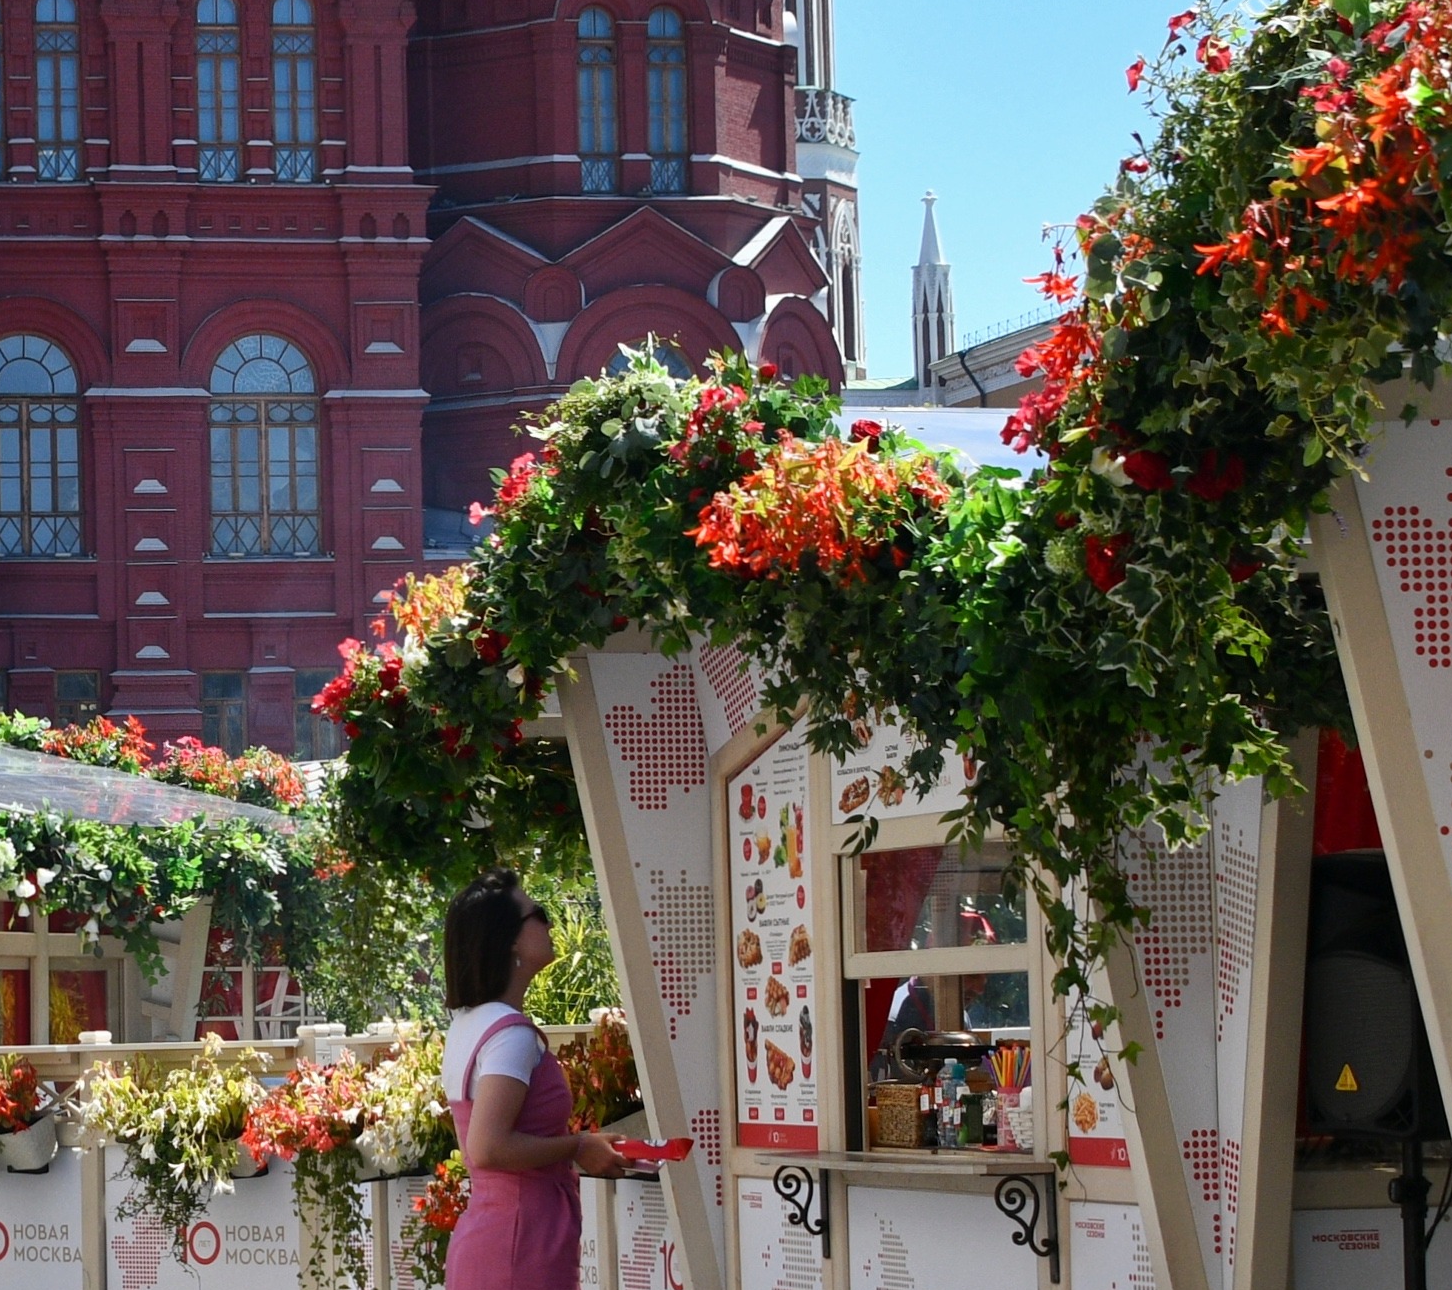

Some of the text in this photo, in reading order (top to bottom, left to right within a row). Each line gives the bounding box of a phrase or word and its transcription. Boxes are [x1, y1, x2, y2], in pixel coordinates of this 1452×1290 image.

[14, 1224, 69, 1240] НОВАЯ
[175, 1221, 284, 1265] 10 НОВАЯ
[14, 1246, 82, 1262] МОСКВА
[226, 1248, 298, 1265] МОСКВА
